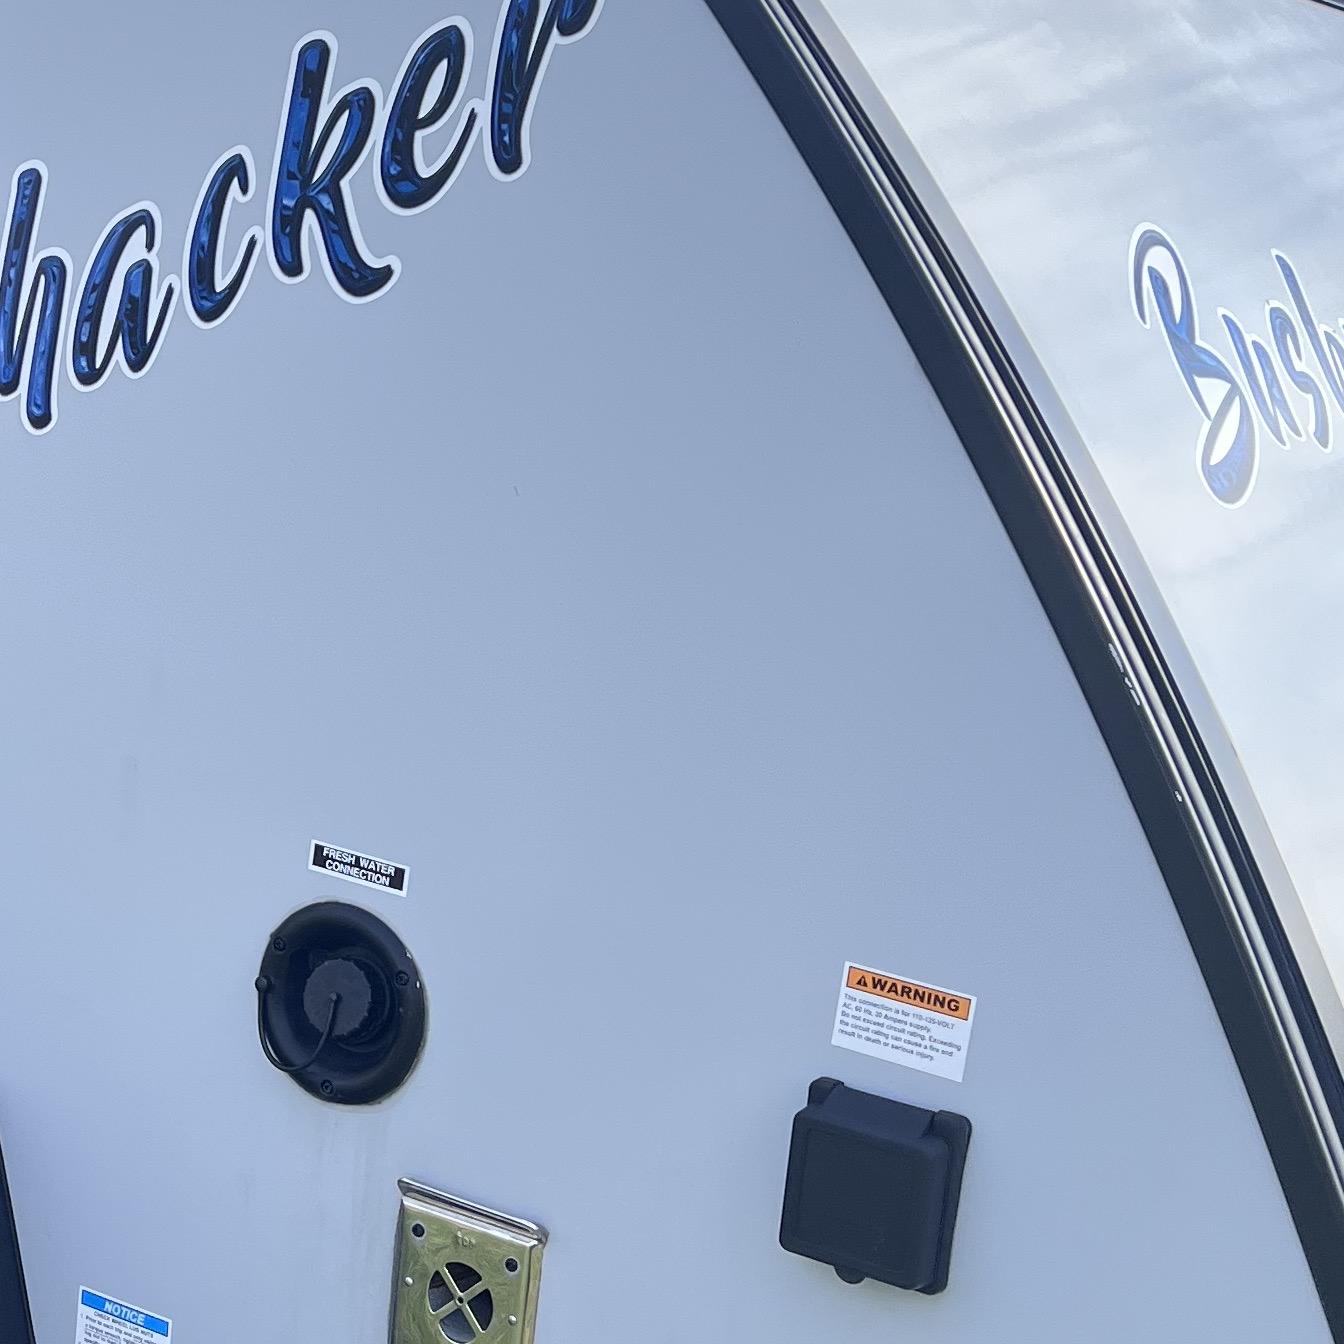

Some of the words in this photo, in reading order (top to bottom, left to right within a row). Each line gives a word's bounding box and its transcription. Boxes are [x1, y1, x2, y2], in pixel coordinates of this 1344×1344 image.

[323, 847, 356, 864] FRESH
[360, 856, 395, 876] WATER
[325, 860, 390, 886] CONNECTION
[843, 993, 856, 1002] This
[901, 1009, 910, 1017] for
[870, 976, 960, 1012] WARNING
[837, 1027, 855, 1037] result
[863, 1035, 881, 1045] death
[890, 1042, 913, 1054] serious
[850, 1022, 870, 1032] circuit
[871, 1028, 889, 1039] rating
[890, 1033, 902, 1042] can
[903, 1037, 922, 1047] cause
[928, 1044, 939, 1052] fire
[941, 1048, 953, 1056] and
[851, 1013, 861, 1021] not
[885, 1023, 905, 1034] circuit
[928, 1035, 961, 1051] Exceeding
[103, 1299, 145, 1326] NOTICE
